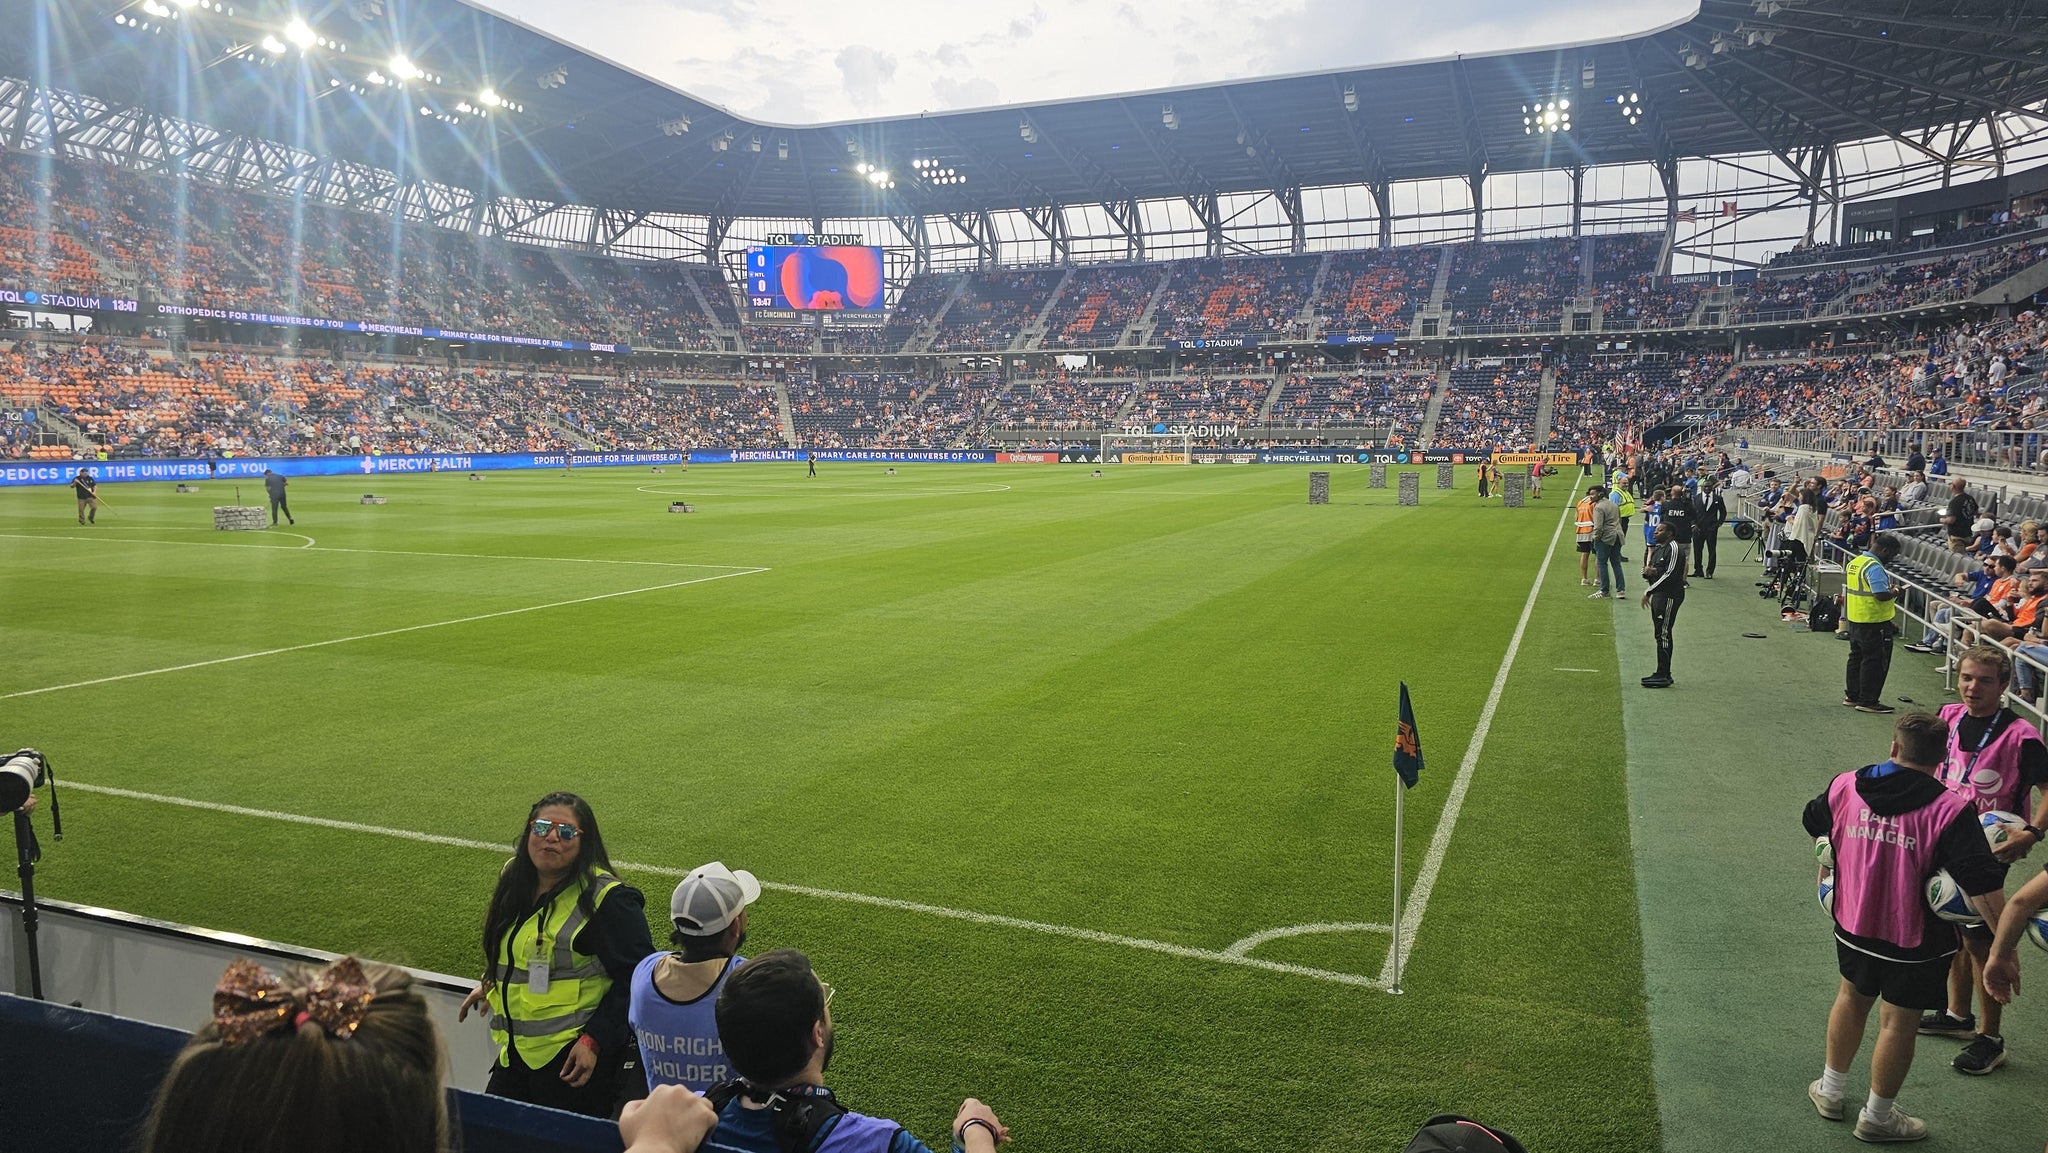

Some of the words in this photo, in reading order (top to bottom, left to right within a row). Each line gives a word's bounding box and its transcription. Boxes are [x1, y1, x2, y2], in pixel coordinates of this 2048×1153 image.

[768, 235, 793, 244] TQL
[808, 235, 863, 245] STADIUM
[758, 255, 765, 267] 0
[1672, 274, 1710, 284] CINCINNATI
[758, 280, 766, 292] 0
[0, 290, 24, 304] TQL
[42, 294, 100, 309] STADIUM
[752, 298, 772, 306] 13:47
[112, 300, 137, 312] 13:47
[158, 305, 226, 318] ORTHOPEDICS
[229, 311, 248, 320] FOR
[250, 313, 267, 322] THE
[270, 314, 312, 326] UNIVERSE
[314, 318, 325, 327] OF
[327, 320, 344, 328] YOU
[764, 310, 796, 318] CINCINNATI
[368, 324, 423, 336] MERCYHEALTH
[440, 330, 468, 339] PRIMARY
[514, 337, 541, 345] UNIVERSE
[1205, 339, 1243, 348] STADIUM
[590, 342, 615, 352] SEATGEEK
[1170, 425, 1238, 437] STADIUM
[534, 456, 564, 464] SPORTS
[621, 454, 634, 462] THE
[739, 451, 795, 461] MERCYHEALTH
[847, 452, 868, 460] CARE
[870, 452, 887, 460] FOR
[890, 452, 905, 460] THE
[908, 452, 949, 460] UNIVERSE
[952, 452, 963, 460] OF
[966, 452, 984, 460] YOU
[1128, 454, 1164, 462] Continental
[1336, 454, 1357, 463] TQL
[1374, 454, 1396, 463] TQL
[1499, 455, 1545, 463] Continental
[1550, 454, 1570, 462] Tire
[378, 457, 472, 470] MERCYHEALTH
[106, 466, 134, 478] THE
[142, 464, 211, 477] UNIVERSE
[219, 464, 237, 474] OF
[241, 463, 268, 474] YOU
[1649, 514, 1660, 526] 10
[1860, 808, 1900, 827] BALL
[1846, 824, 1917, 850] MANAGER
[653, 1060, 727, 1082] HOLDER
